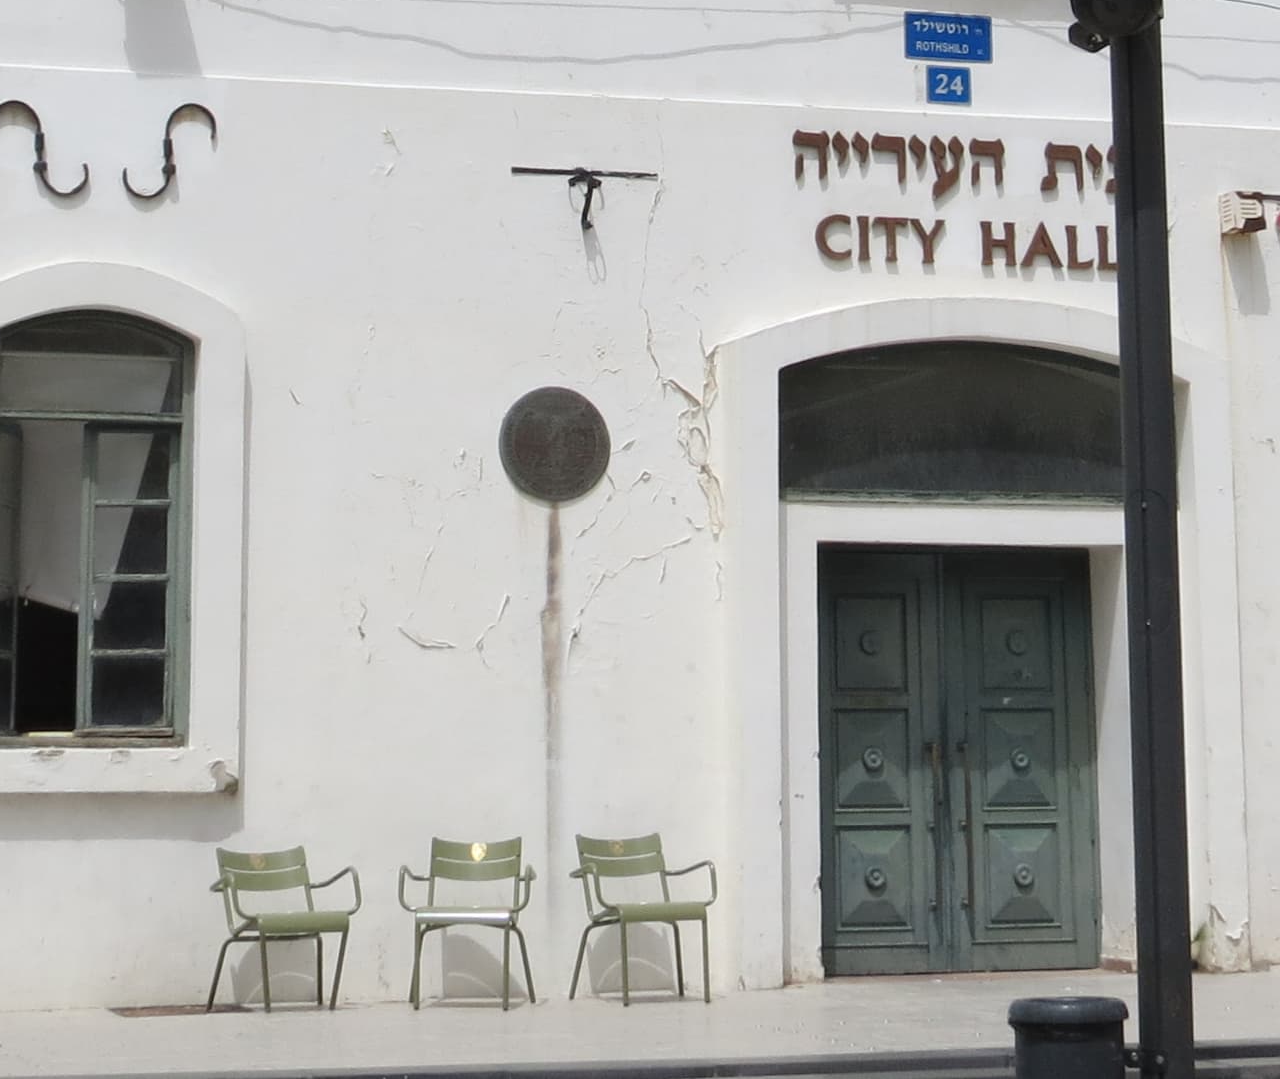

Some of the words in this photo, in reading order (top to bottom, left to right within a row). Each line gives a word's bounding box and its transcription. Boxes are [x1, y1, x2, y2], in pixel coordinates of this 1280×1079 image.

[913, 19, 969, 35] רוטשילד
[935, 73, 964, 96] 24
[792, 129, 1005, 200] העירייה
[815, 214, 945, 264] CITY
[980, 221, 1119, 271] HALL
